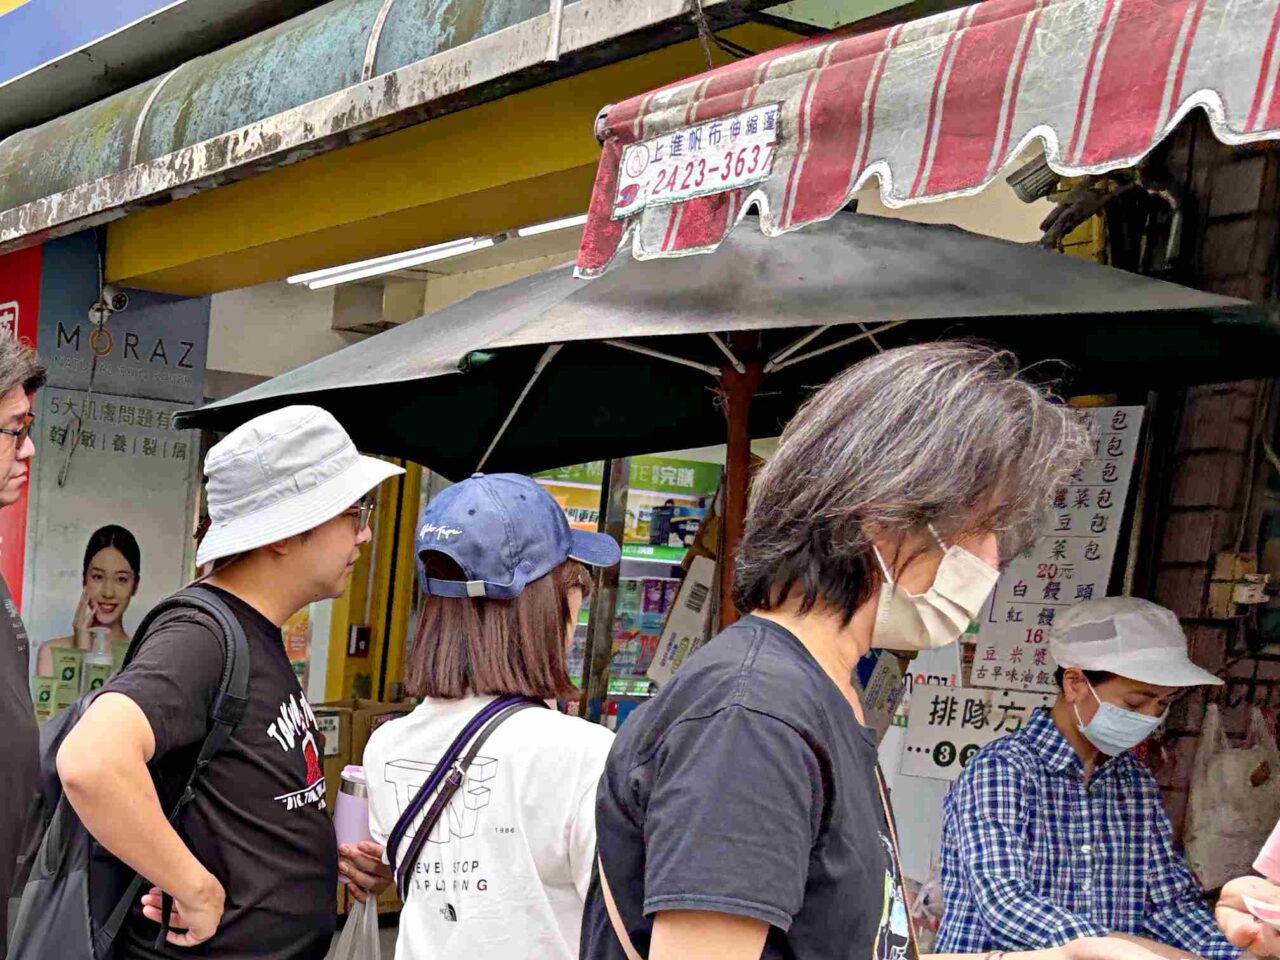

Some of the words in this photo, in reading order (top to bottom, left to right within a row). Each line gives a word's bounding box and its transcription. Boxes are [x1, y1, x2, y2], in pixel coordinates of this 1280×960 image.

[56, 321, 195, 369] MORAZ
[50, 396, 174, 430] 5大肌膚問題有
[928, 693, 1051, 733] 排隊方
